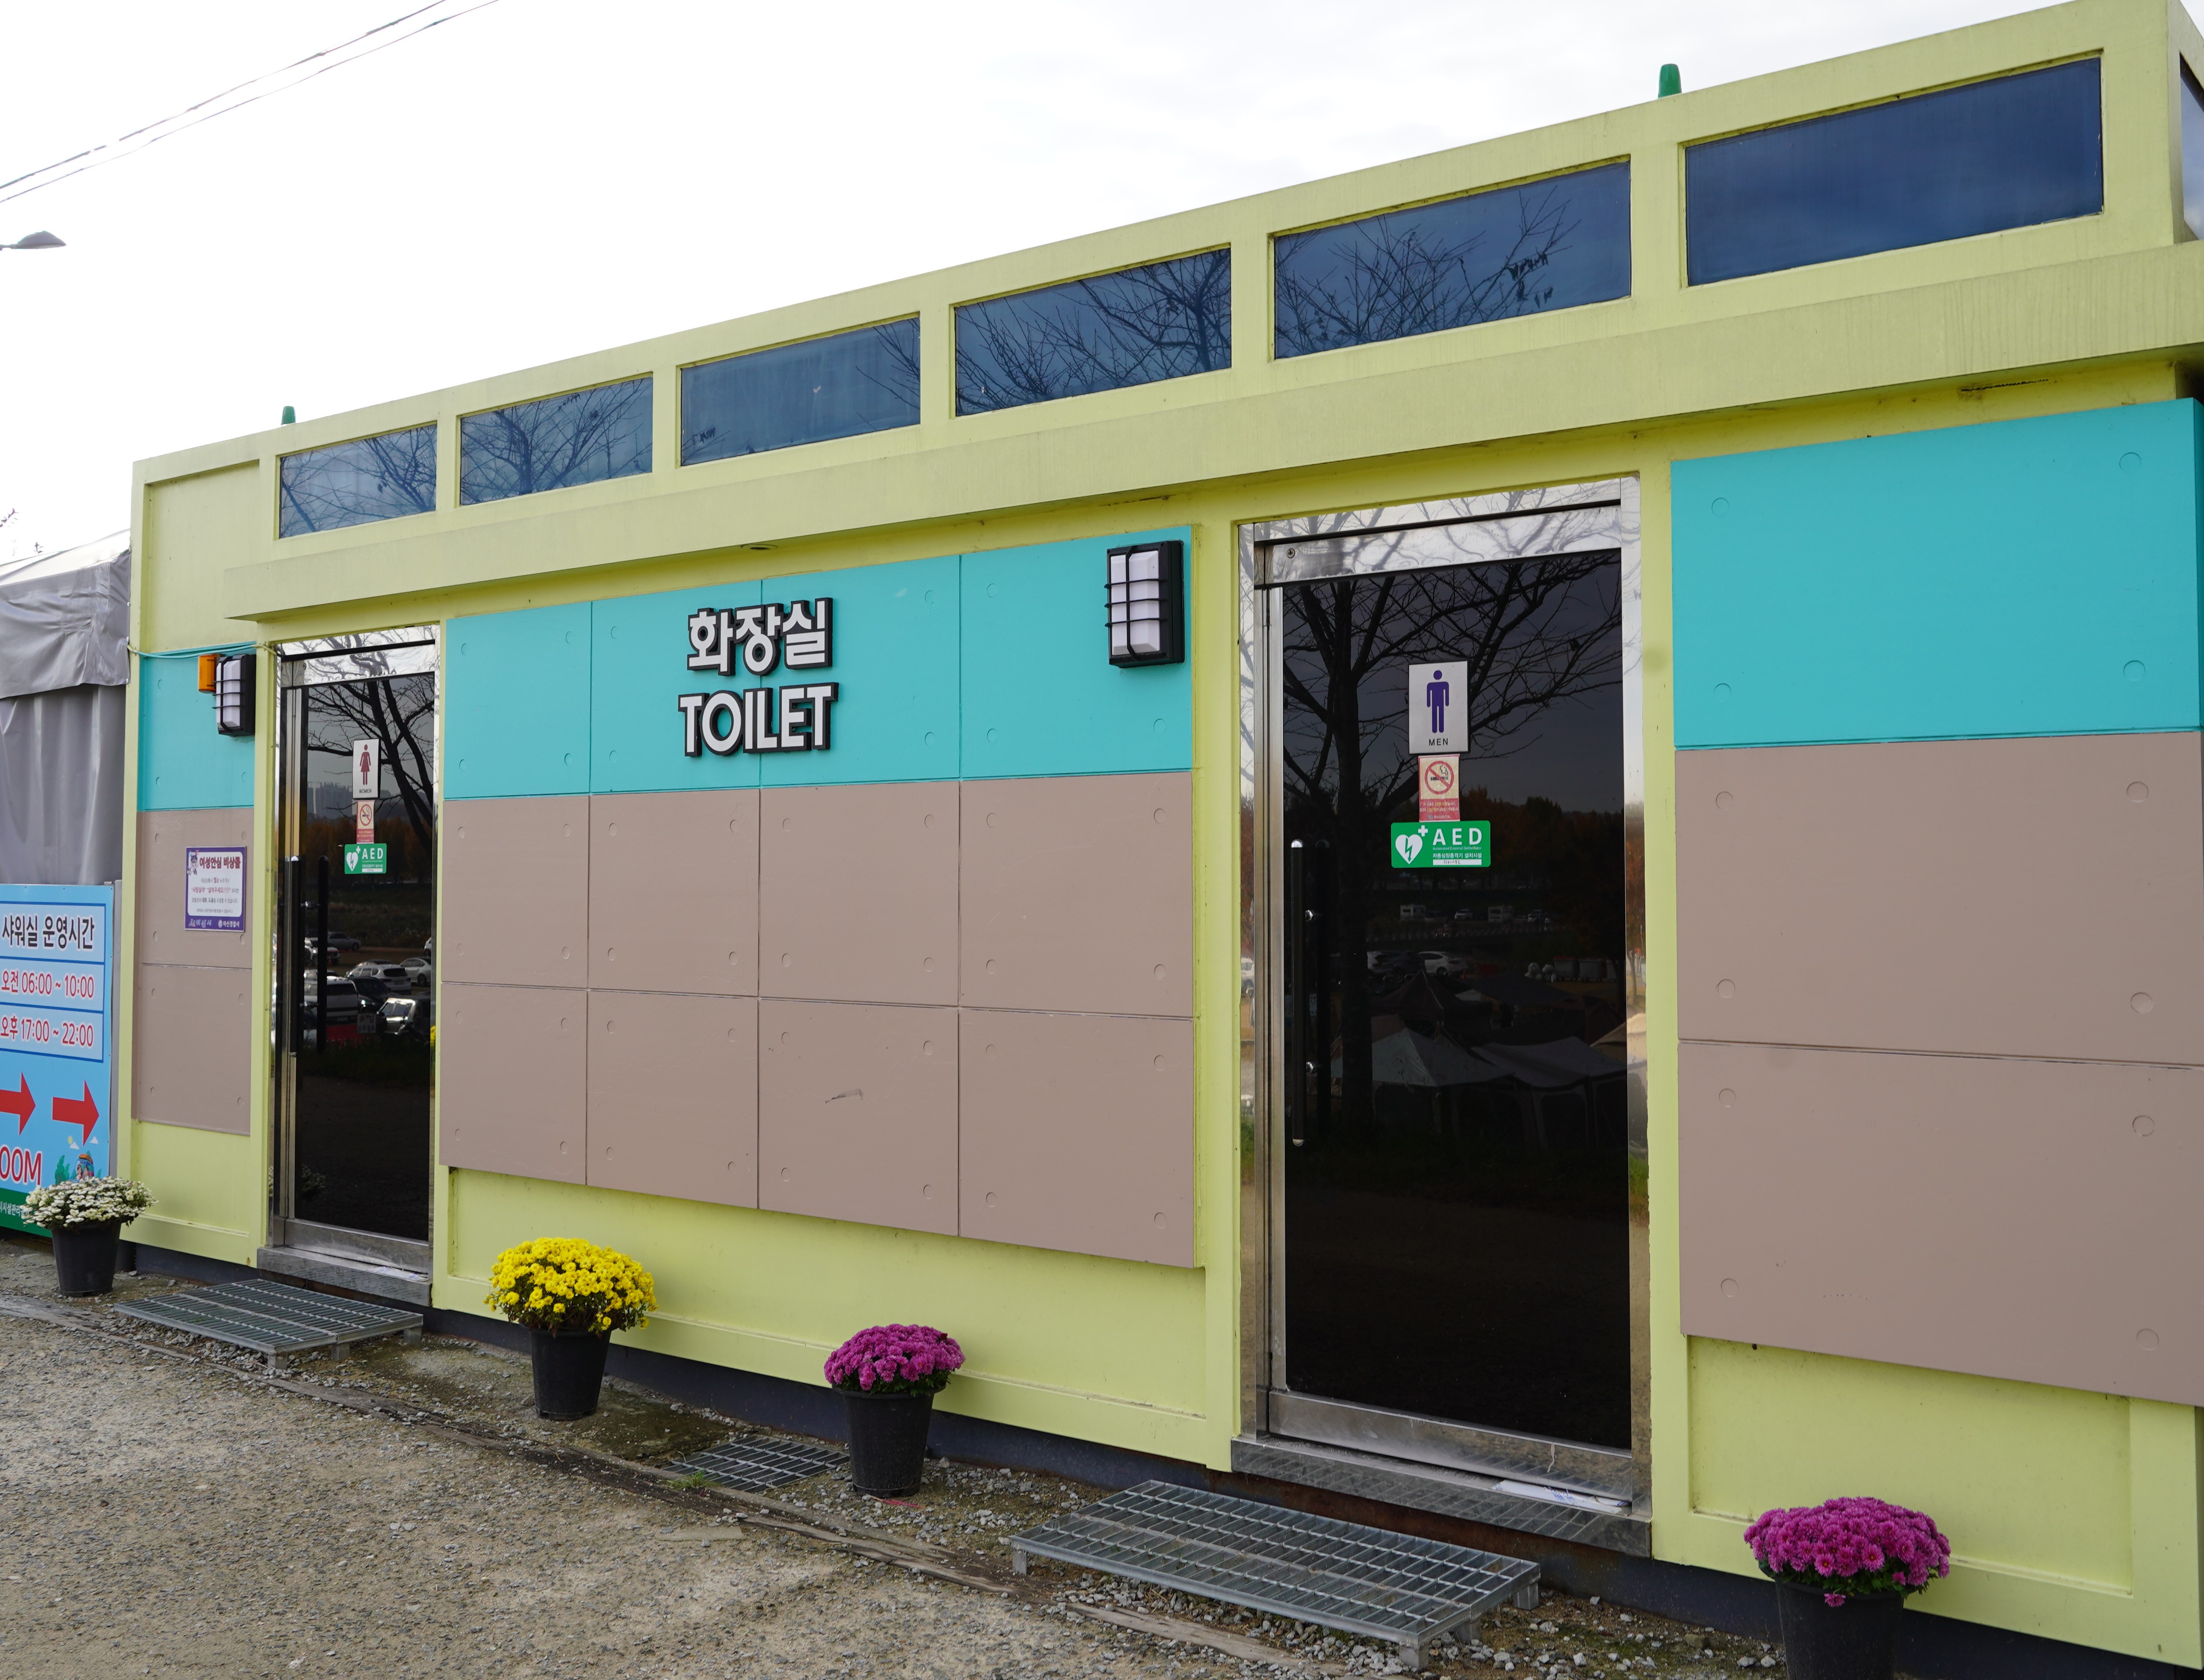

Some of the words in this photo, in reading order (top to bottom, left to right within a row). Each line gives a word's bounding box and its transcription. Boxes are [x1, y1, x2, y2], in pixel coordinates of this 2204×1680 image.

[687, 597, 833, 676] 화장실
[678, 682, 839, 757] TOILET
[1432, 828, 1482, 845] AED
[200, 856, 221, 869] 여성안심
[362, 848, 383, 859] AED
[2, 915, 38, 948] 샤워실
[43, 915, 95, 949] 운영시간
[1, 970, 19, 993] 오전
[22, 972, 52, 995] 06:00
[65, 975, 94, 998] 10:00
[0, 1015, 18, 1040] 오후
[21, 1018, 50, 1042] 17:00
[62, 1022, 93, 1047] 22:00
[0, 1201, 29, 1218] 시시설관리
